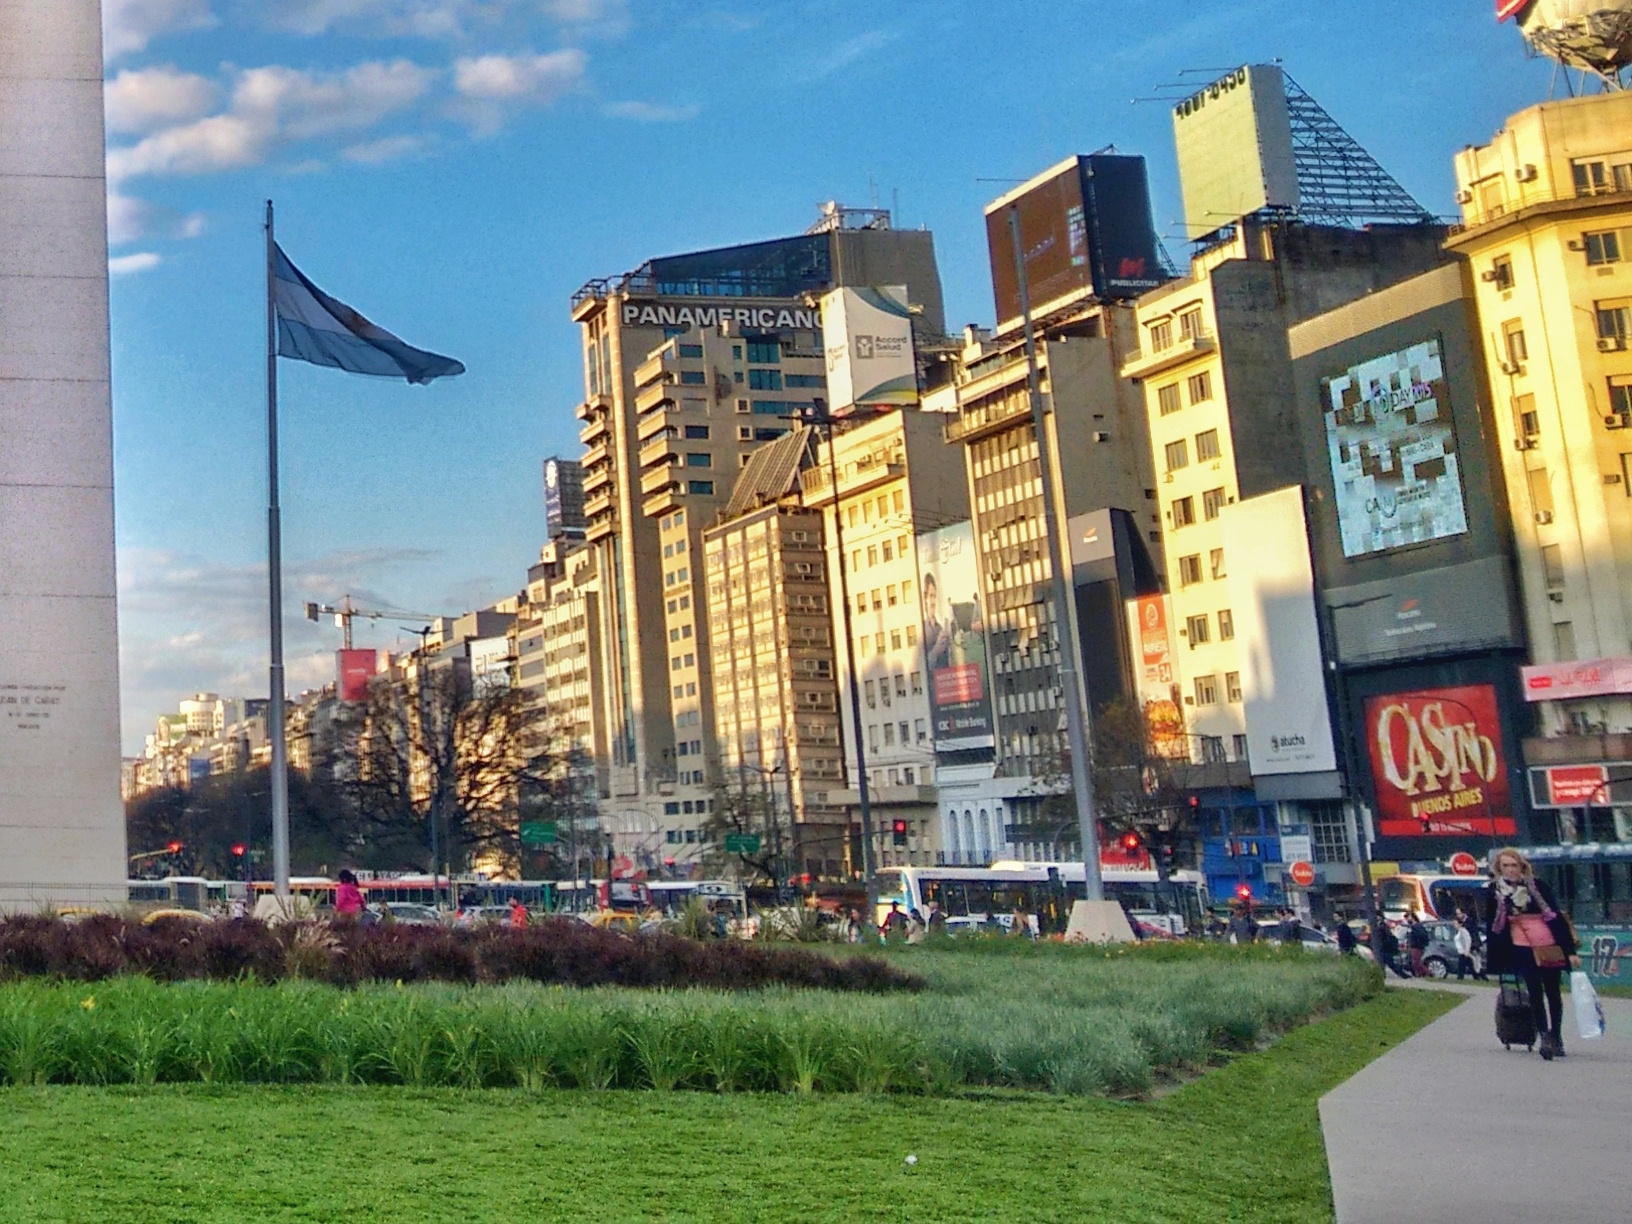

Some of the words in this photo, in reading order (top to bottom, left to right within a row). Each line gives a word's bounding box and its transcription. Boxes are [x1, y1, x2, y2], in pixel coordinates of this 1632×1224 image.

[1280, 734, 1305, 747] atucha
[1378, 702, 1497, 795] CASINO
[1411, 794, 1452, 817] BUENOS
[1453, 788, 1483, 809] AIRES
